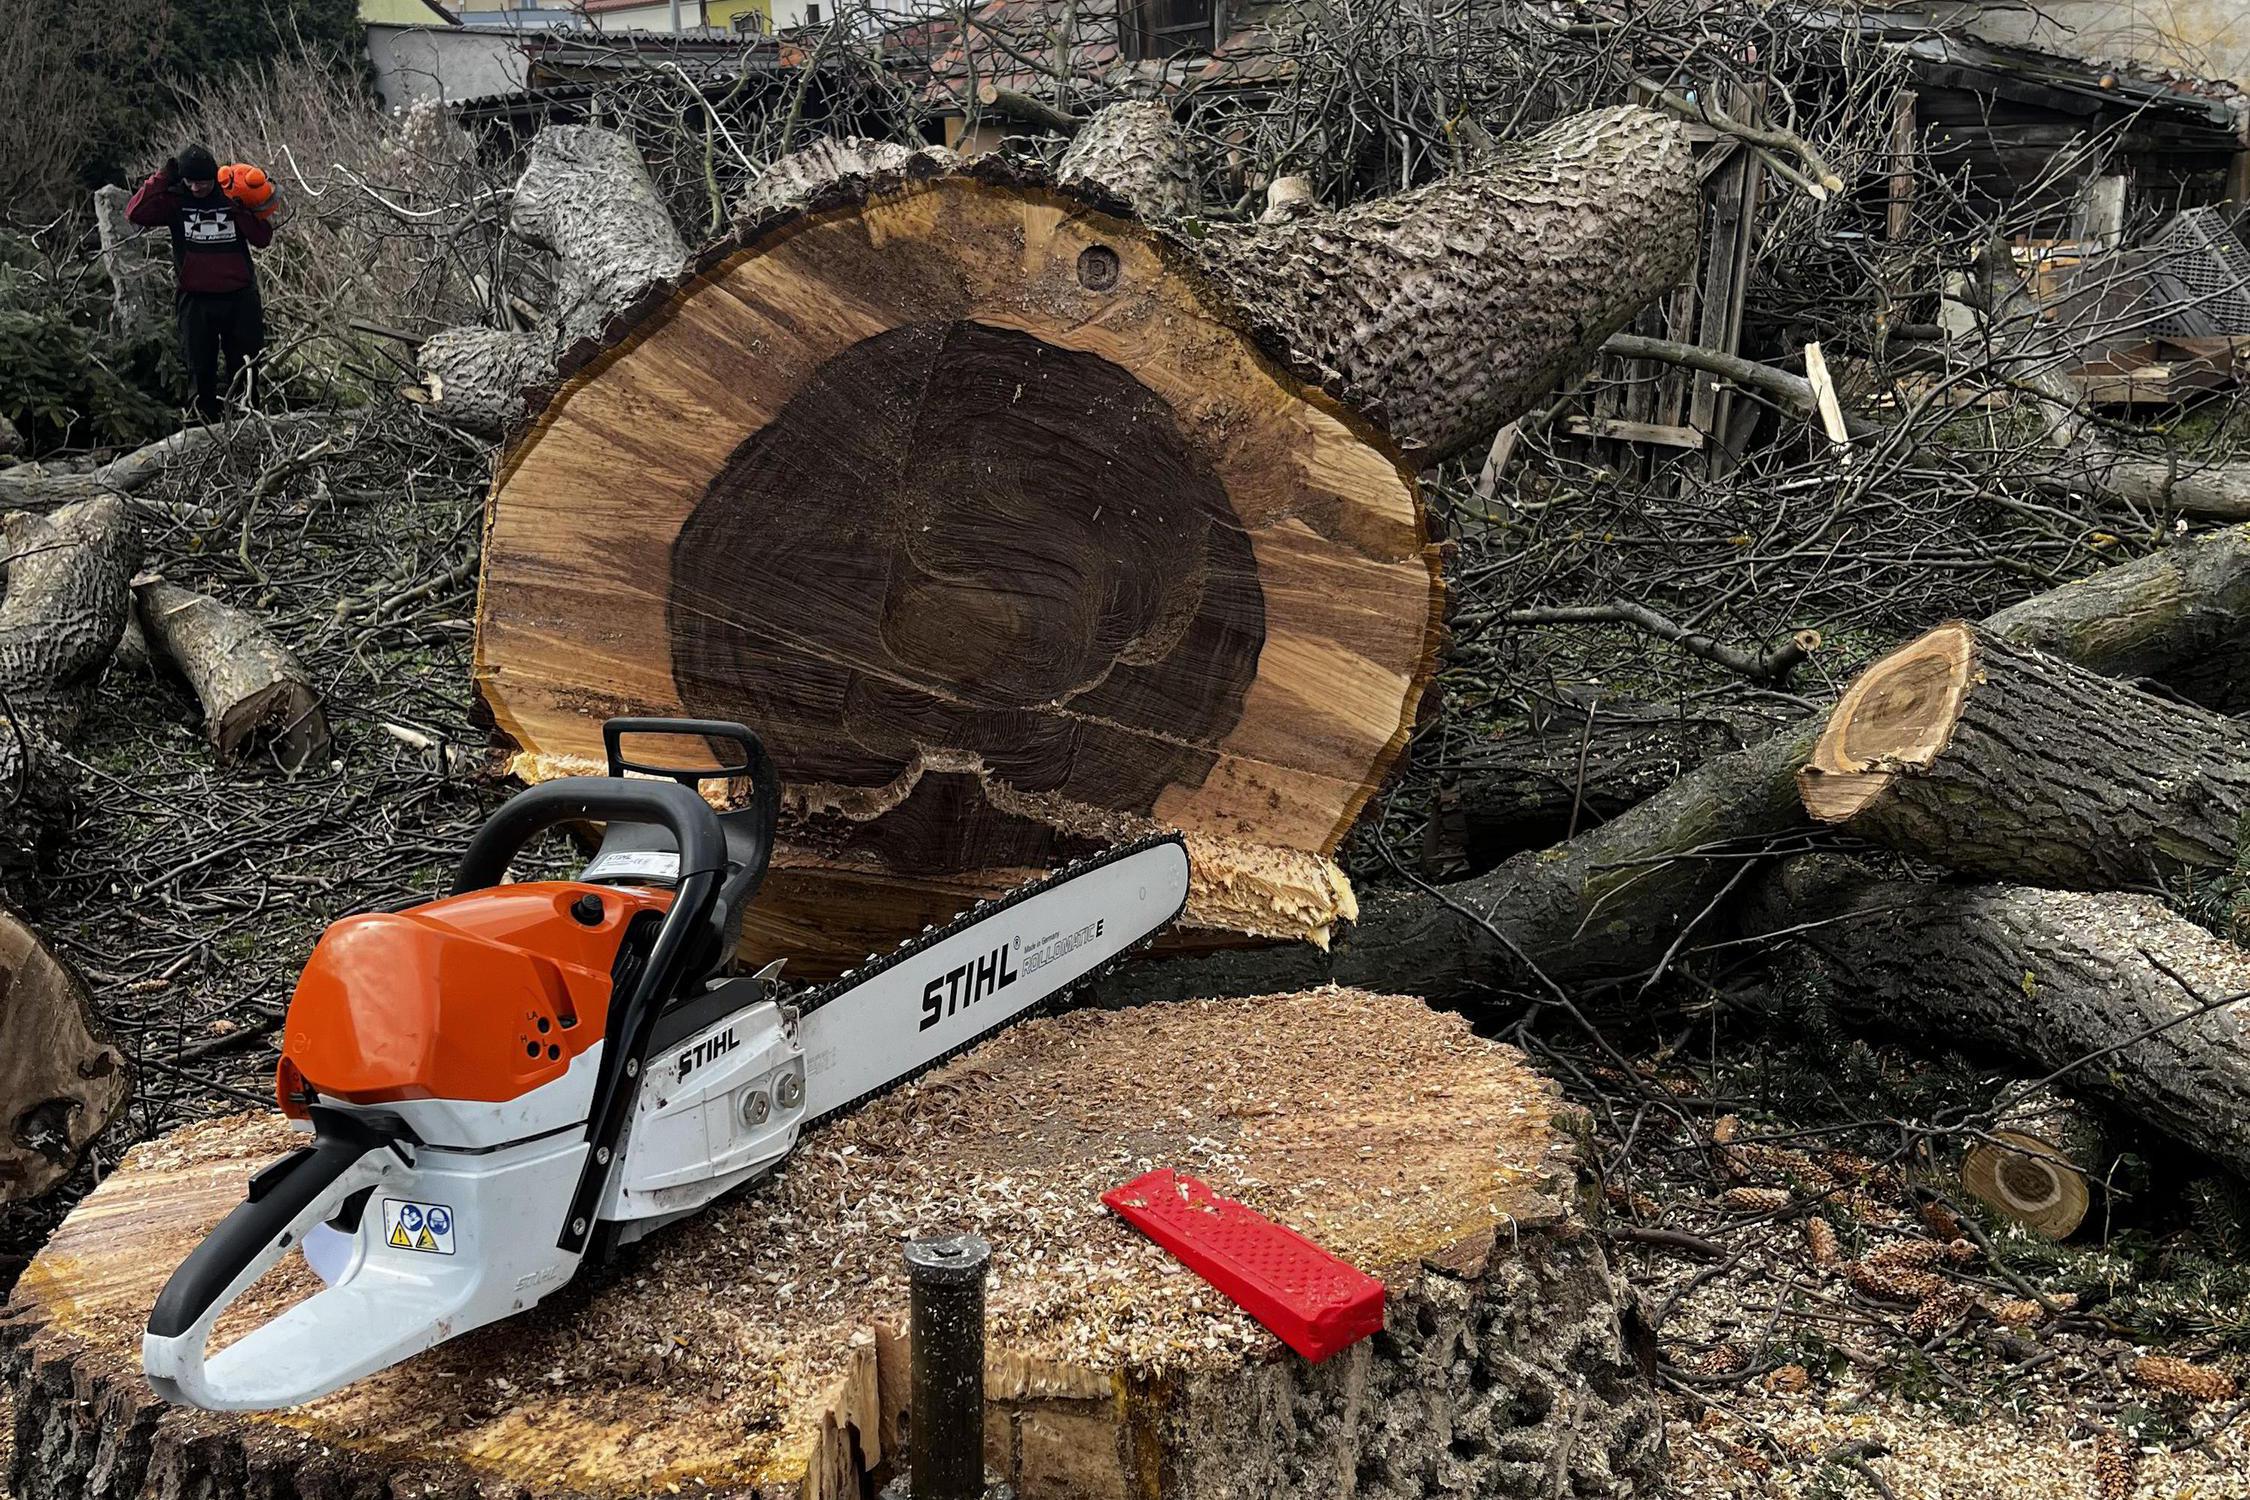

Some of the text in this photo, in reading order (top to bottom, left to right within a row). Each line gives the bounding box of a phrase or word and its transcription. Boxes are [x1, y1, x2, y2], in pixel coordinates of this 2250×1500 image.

[1021, 918, 1104, 978] ROLLOMATIC E
[1024, 944, 1036, 954] Made
[1041, 931, 1060, 946] Germany
[526, 1010, 538, 1020] LA
[520, 1034, 528, 1043] H
[677, 1027, 741, 1082] STIHL
